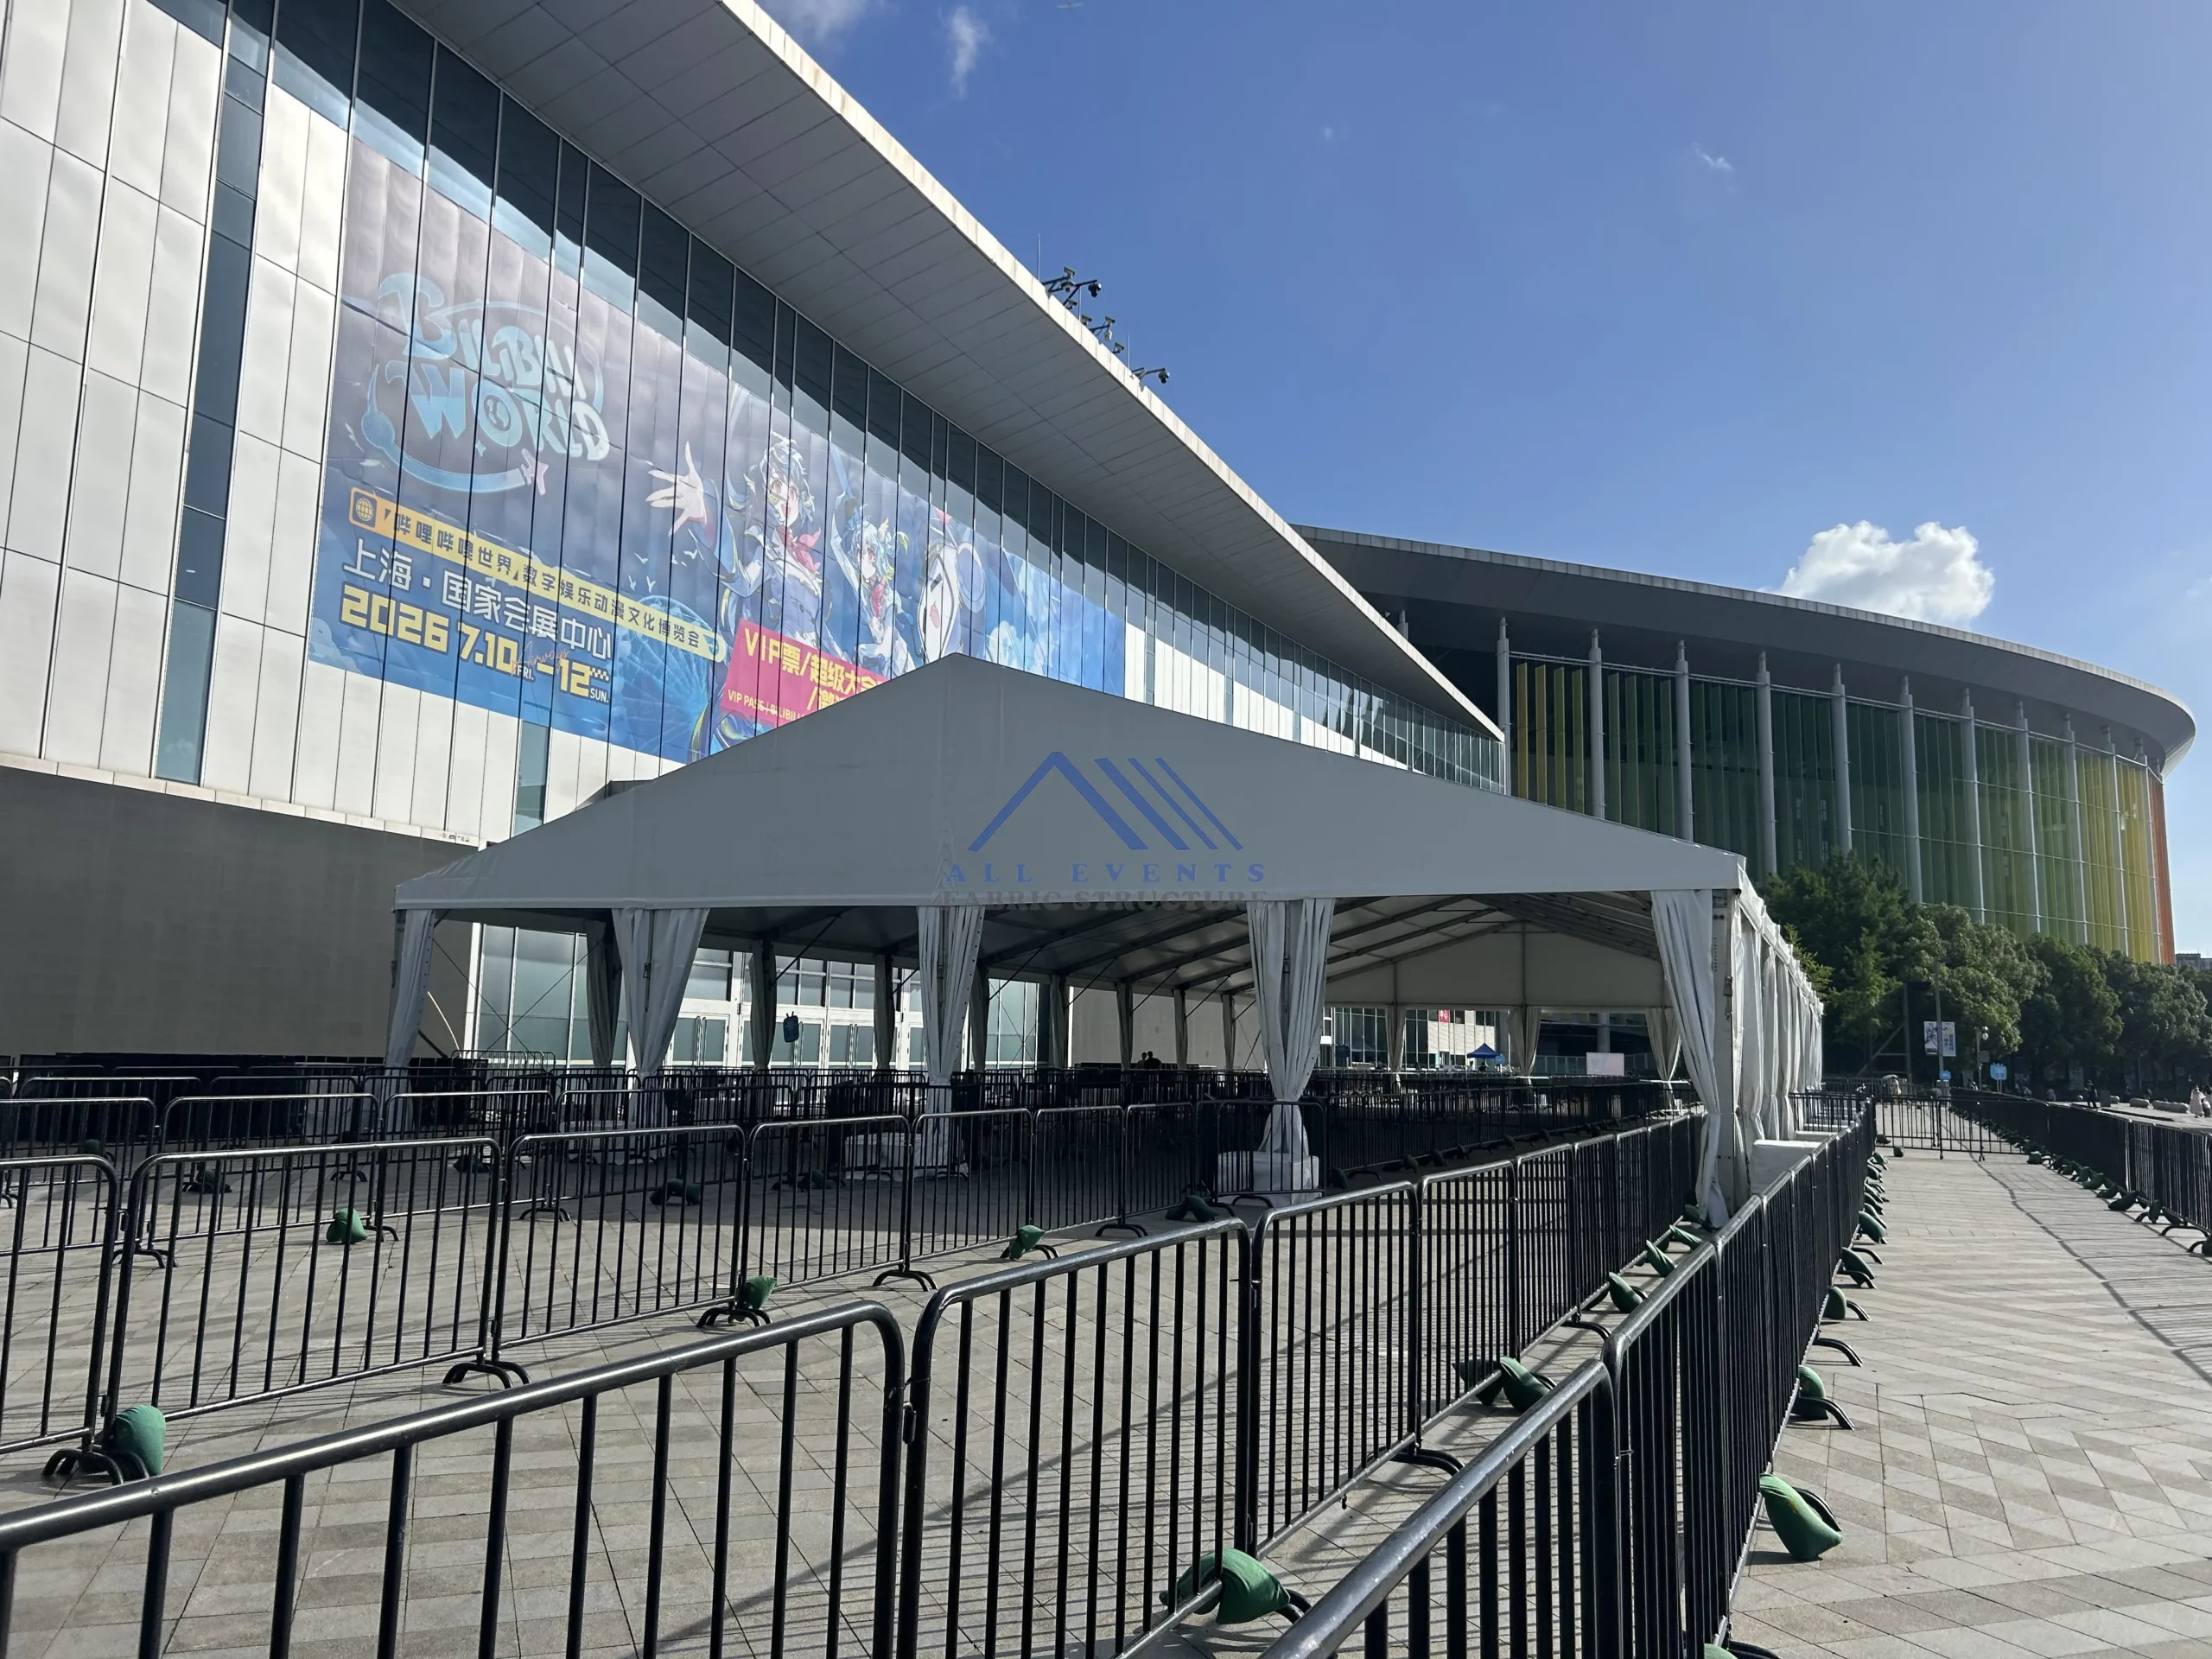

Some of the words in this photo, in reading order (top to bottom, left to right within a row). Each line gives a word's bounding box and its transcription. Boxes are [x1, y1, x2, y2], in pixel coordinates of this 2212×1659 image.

[385, 360, 610, 461] WORLD
[341, 584, 449, 652] 2026
[458, 622, 518, 675] 7.10
[728, 689, 742, 703] VIP
